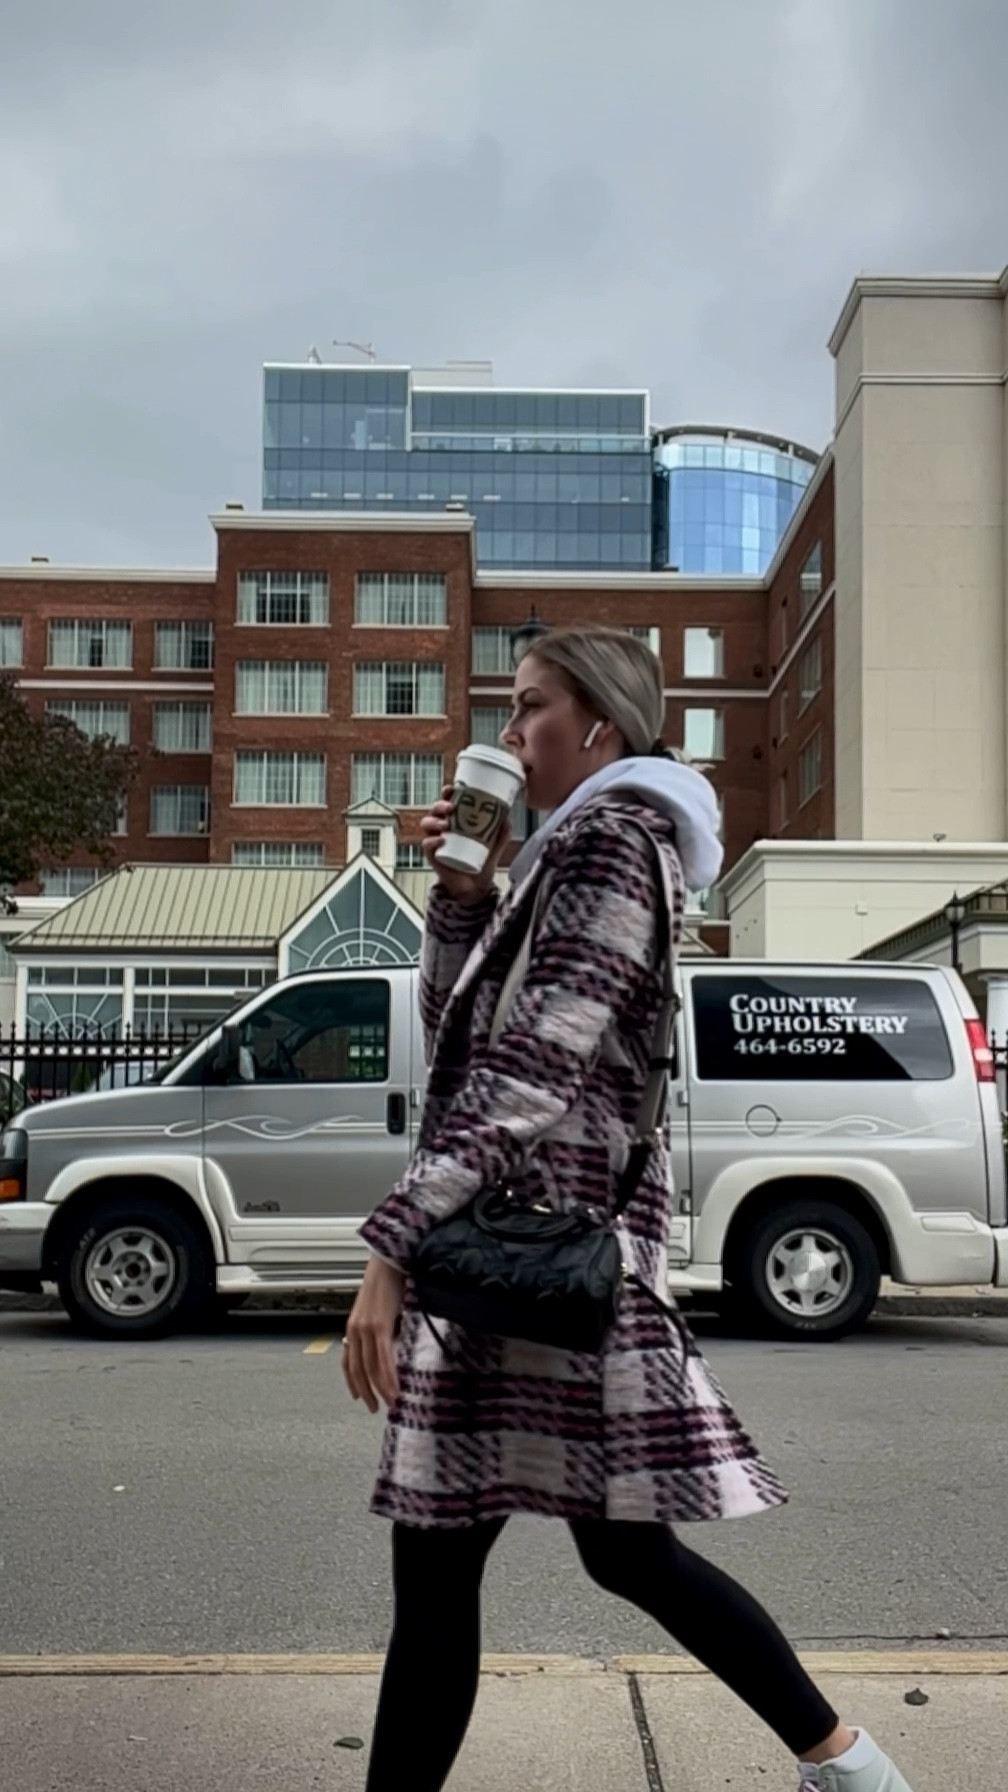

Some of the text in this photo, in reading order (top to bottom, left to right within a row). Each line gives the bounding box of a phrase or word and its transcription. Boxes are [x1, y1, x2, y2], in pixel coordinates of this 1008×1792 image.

[730, 994, 857, 1013] COUNTRY
[733, 1014, 908, 1033] UPHOLSTERY
[734, 1039, 846, 1054] 464-6592
